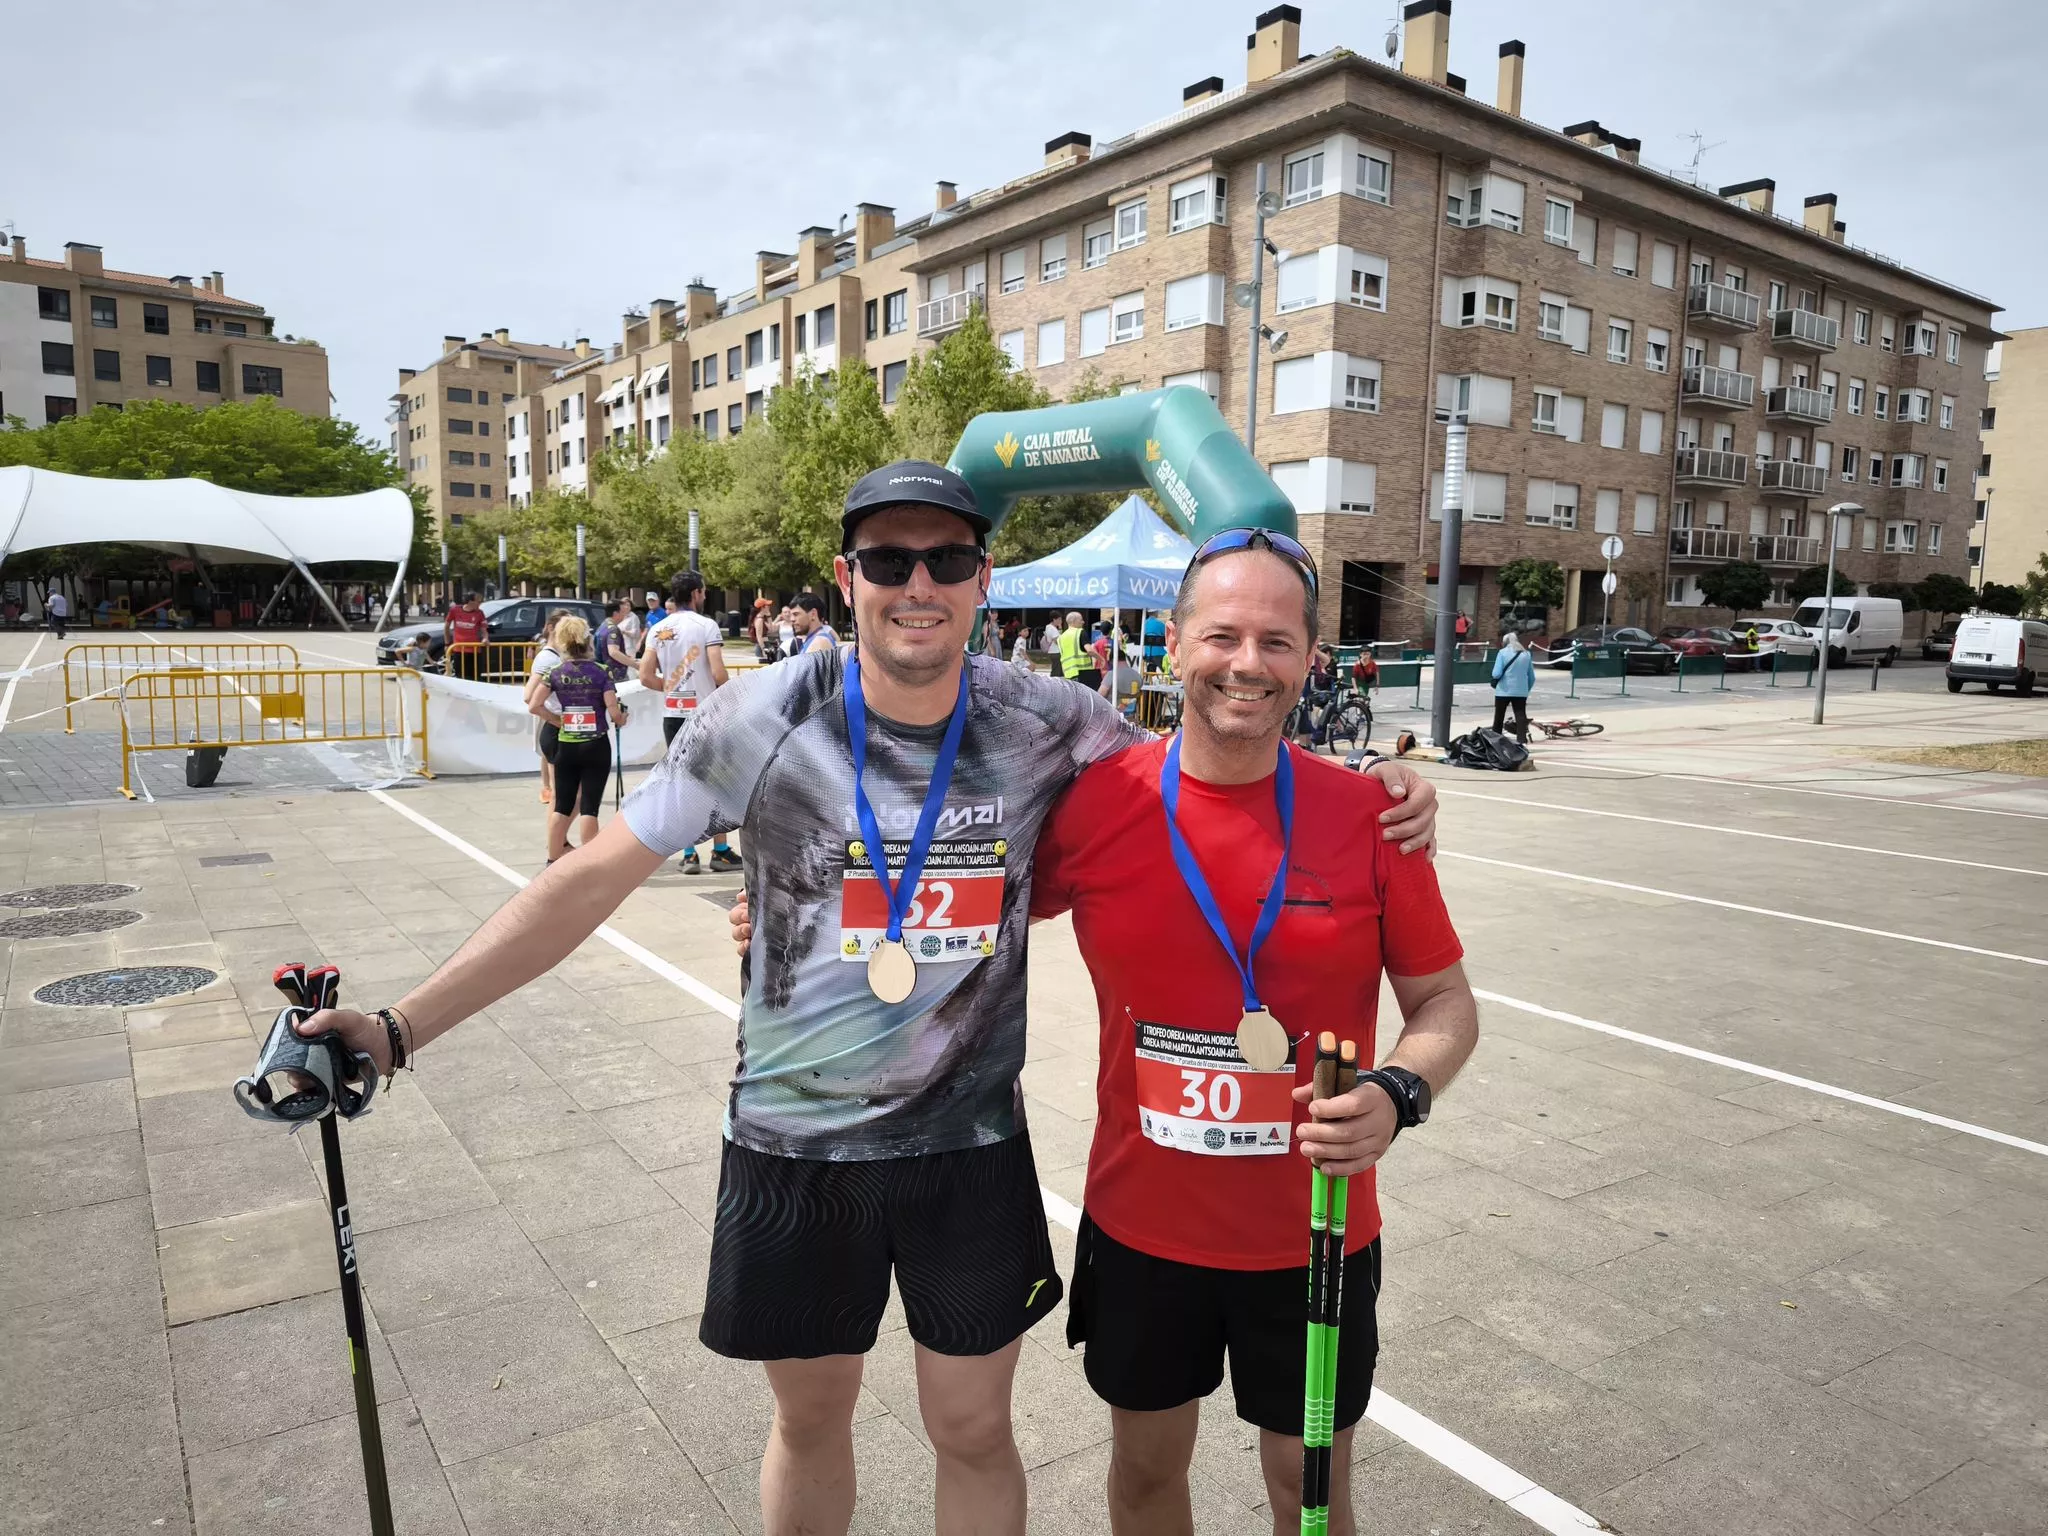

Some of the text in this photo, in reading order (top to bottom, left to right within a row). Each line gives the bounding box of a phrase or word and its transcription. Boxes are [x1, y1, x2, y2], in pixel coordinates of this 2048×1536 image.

[1023, 426, 1093, 450] CAJA RURAL
[1023, 444, 1101, 467] DE NAVARRA
[1156, 466, 1196, 526] DE NAVARRA
[1161, 459, 1199, 514] CAJA RURAL
[992, 572, 1109, 600] w.rs-sport.es
[676, 699, 684, 708] 6
[571, 714, 585, 724] 49
[954, 841, 995, 853] ANSOÁIN-ARTIC
[966, 854, 999, 865] TXAPELKETA
[1146, 1025, 1167, 1038] TROFEO
[1167, 1029, 1186, 1041] OREKA
[1186, 1033, 1210, 1044] MARCHA
[1143, 1036, 1241, 1058] OREKA IPAR MARTXA ANTSOAIN-ART
[1178, 1069, 1242, 1122] 30
[336, 1203, 357, 1275] LEKI
